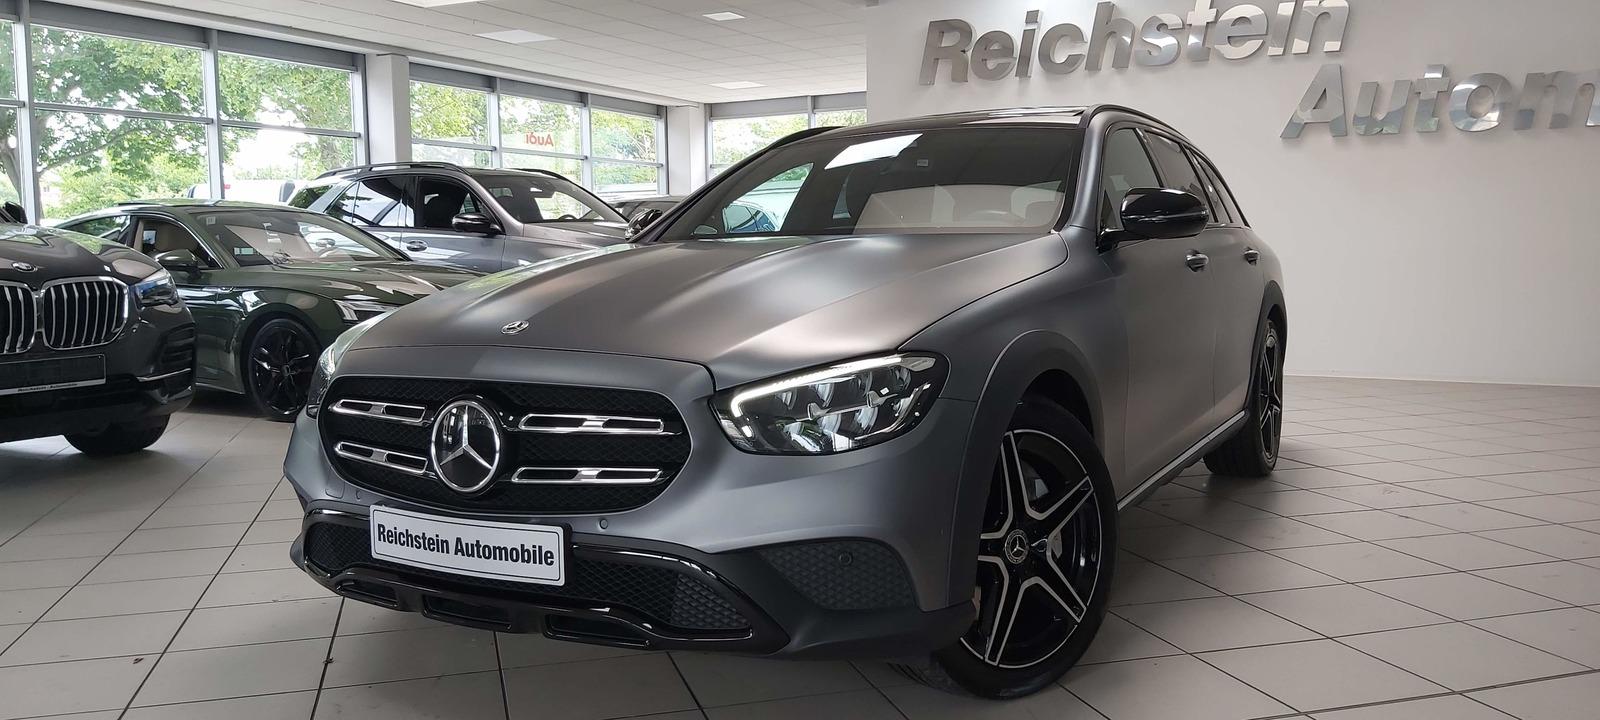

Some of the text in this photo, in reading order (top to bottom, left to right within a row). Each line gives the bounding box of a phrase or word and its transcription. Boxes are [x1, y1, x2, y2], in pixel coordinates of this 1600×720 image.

[920, 0, 1350, 86] Reichstein
[377, 523, 555, 566] Reichstein Automobile
